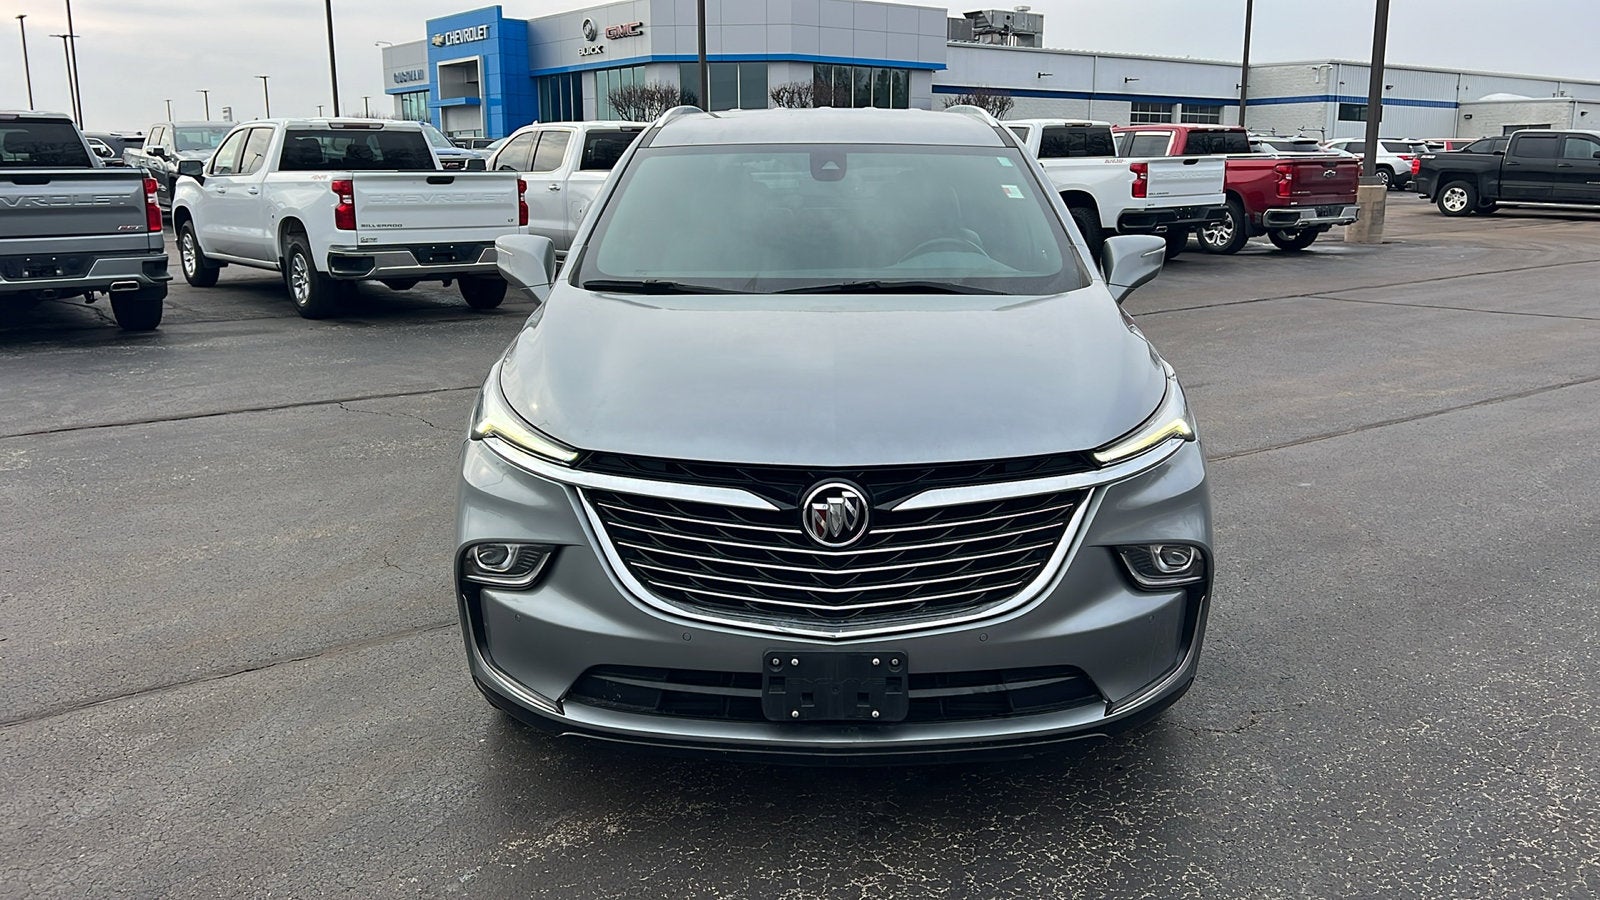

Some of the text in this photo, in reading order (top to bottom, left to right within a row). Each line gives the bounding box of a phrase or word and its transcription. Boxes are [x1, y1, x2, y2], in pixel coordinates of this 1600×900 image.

[445, 24, 489, 46] CHEVROLET
[605, 21, 643, 40] GMC
[578, 45, 604, 56] BUICK
